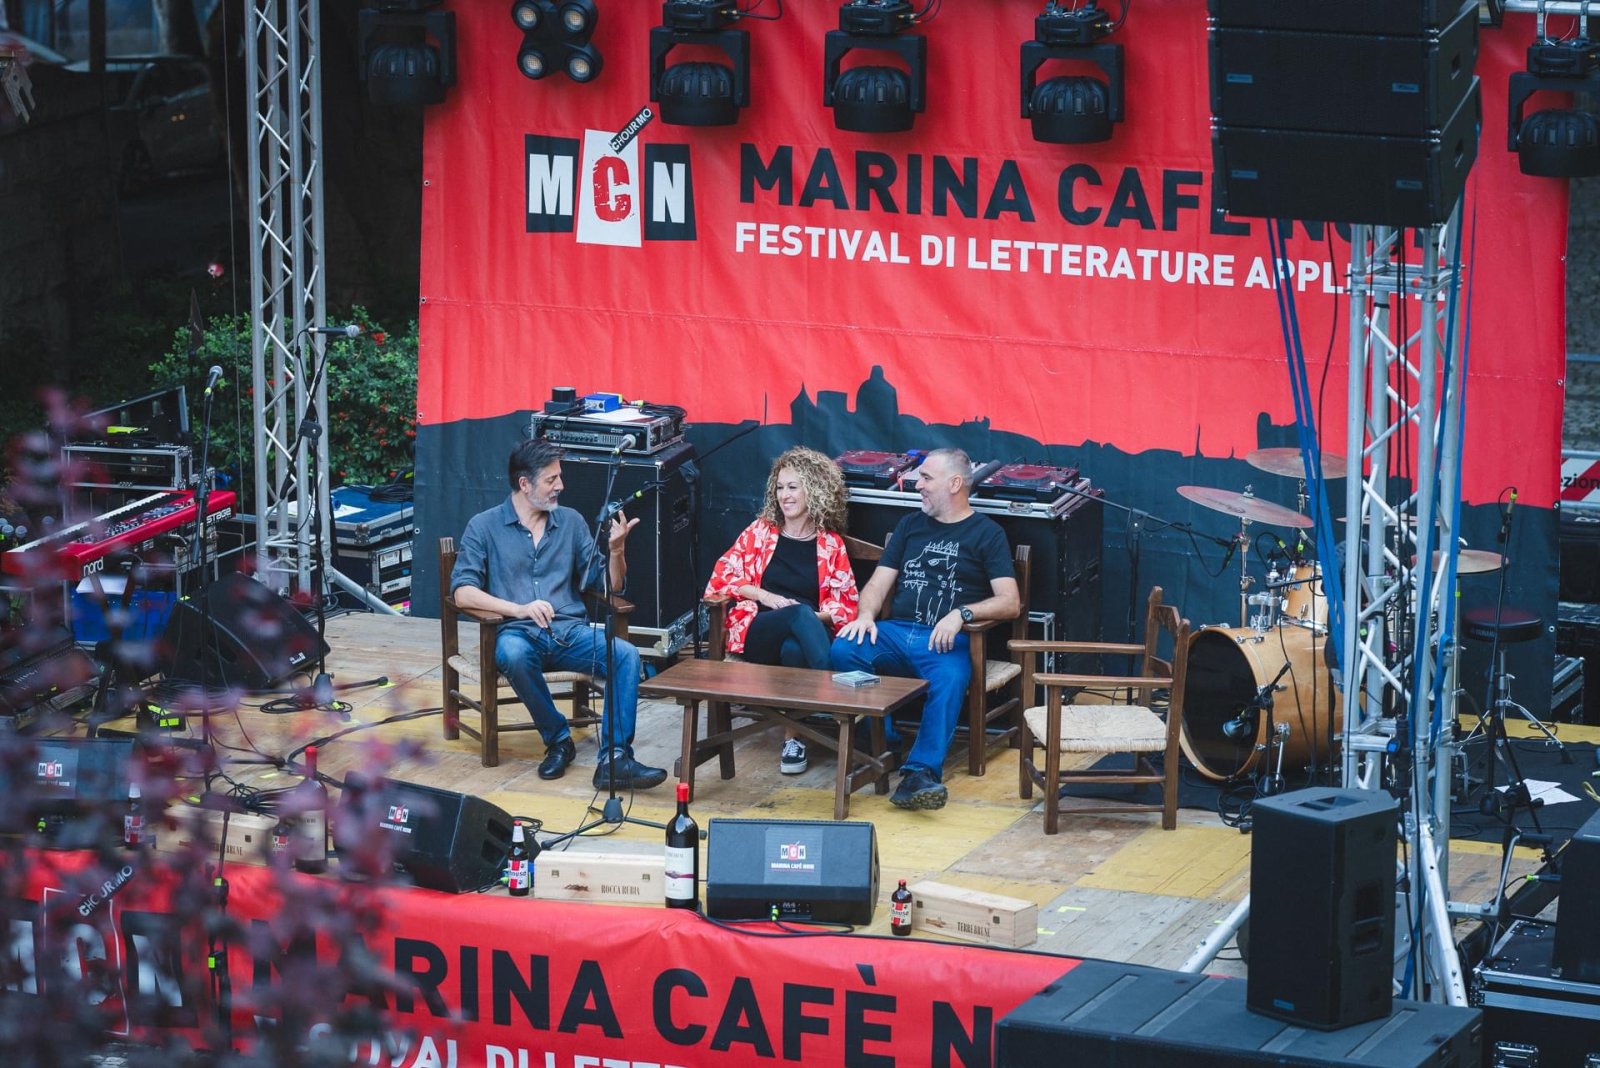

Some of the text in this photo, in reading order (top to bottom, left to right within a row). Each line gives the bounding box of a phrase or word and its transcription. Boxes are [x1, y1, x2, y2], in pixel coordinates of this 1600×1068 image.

[611, 107, 652, 151] CHOURMO
[740, 142, 1035, 223] MARINA
[735, 222, 910, 265] FESTIVAL
[920, 234, 955, 268] DI
[967, 237, 1235, 287] LETTERATURE
[83, 556, 104, 577] nord
[601, 884, 621, 895] ROCCA
[652, 963, 897, 1068] CAFÈ
